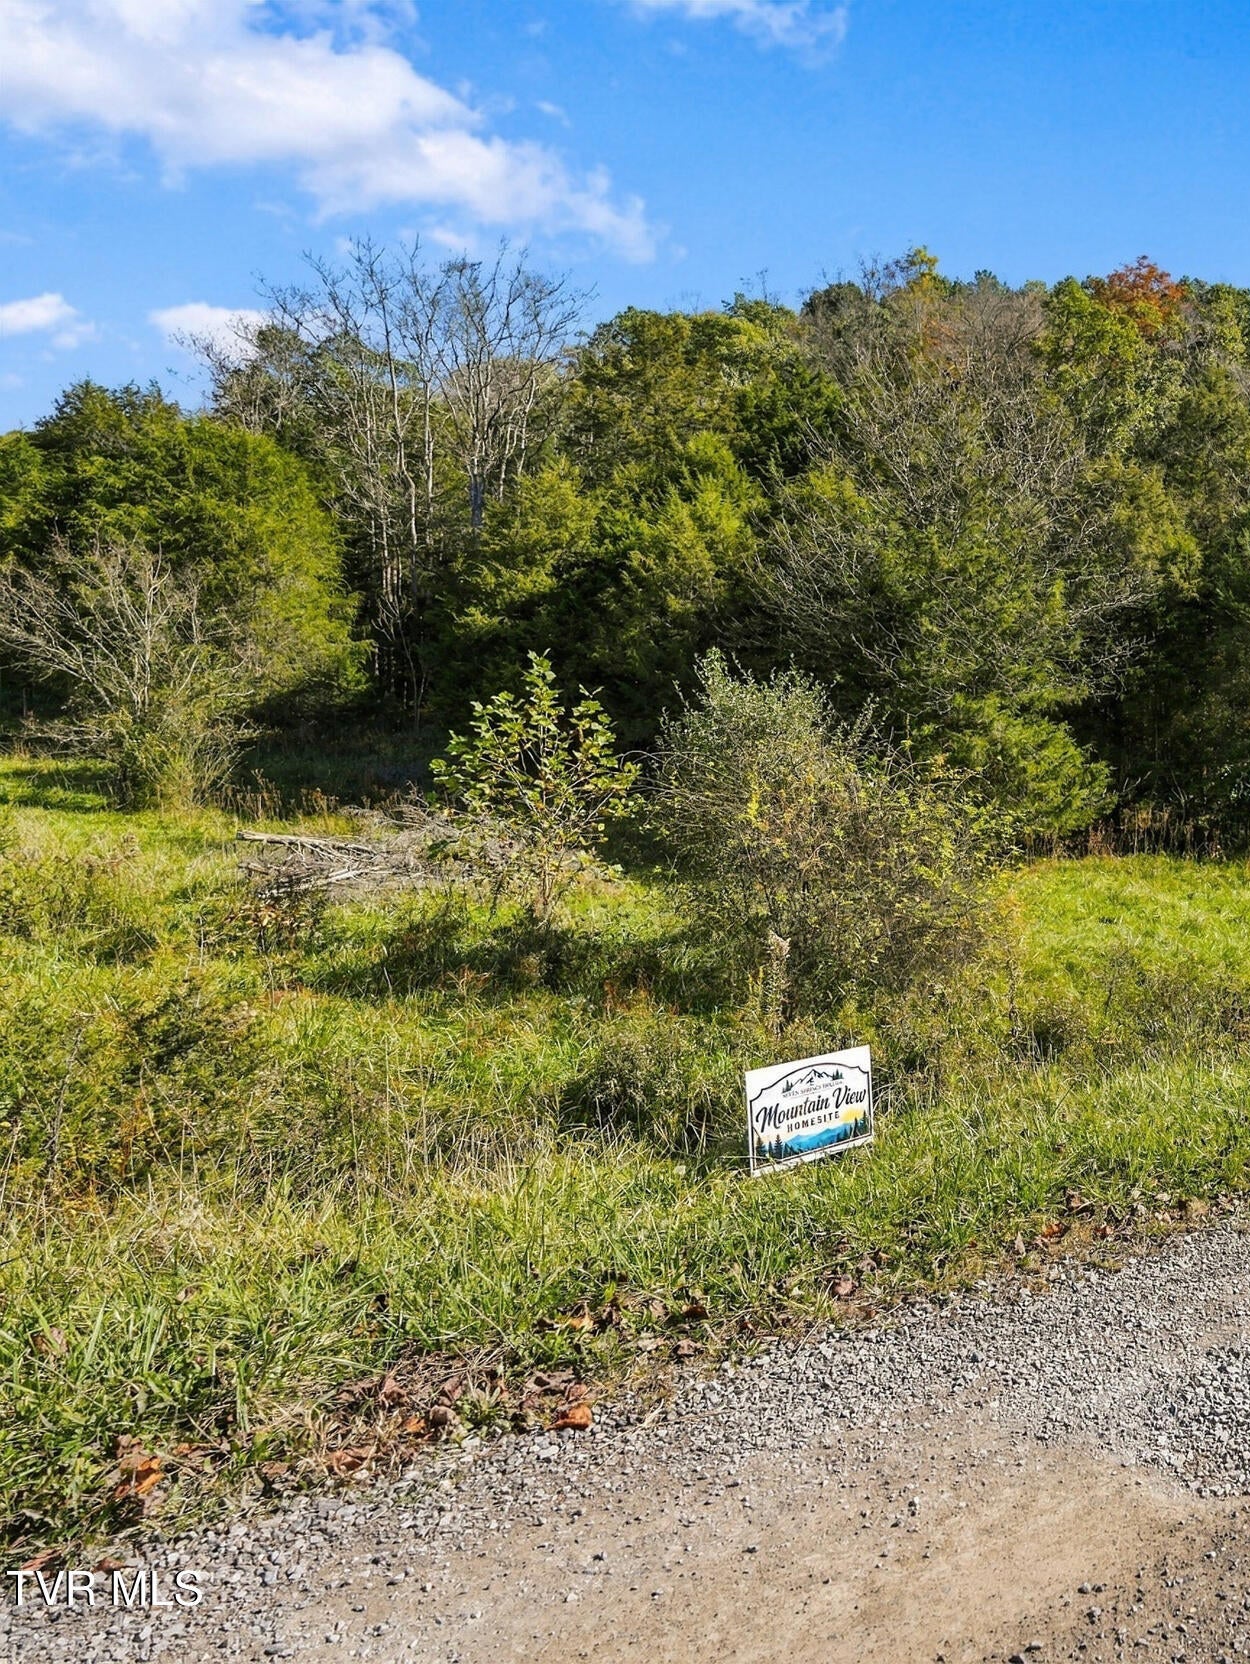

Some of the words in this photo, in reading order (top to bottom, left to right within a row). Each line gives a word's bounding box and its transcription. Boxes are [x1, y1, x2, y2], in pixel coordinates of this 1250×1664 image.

[756, 1096, 830, 1133] Mountain
[832, 1085, 866, 1108] View
[787, 1110, 840, 1132] HOMESITE
